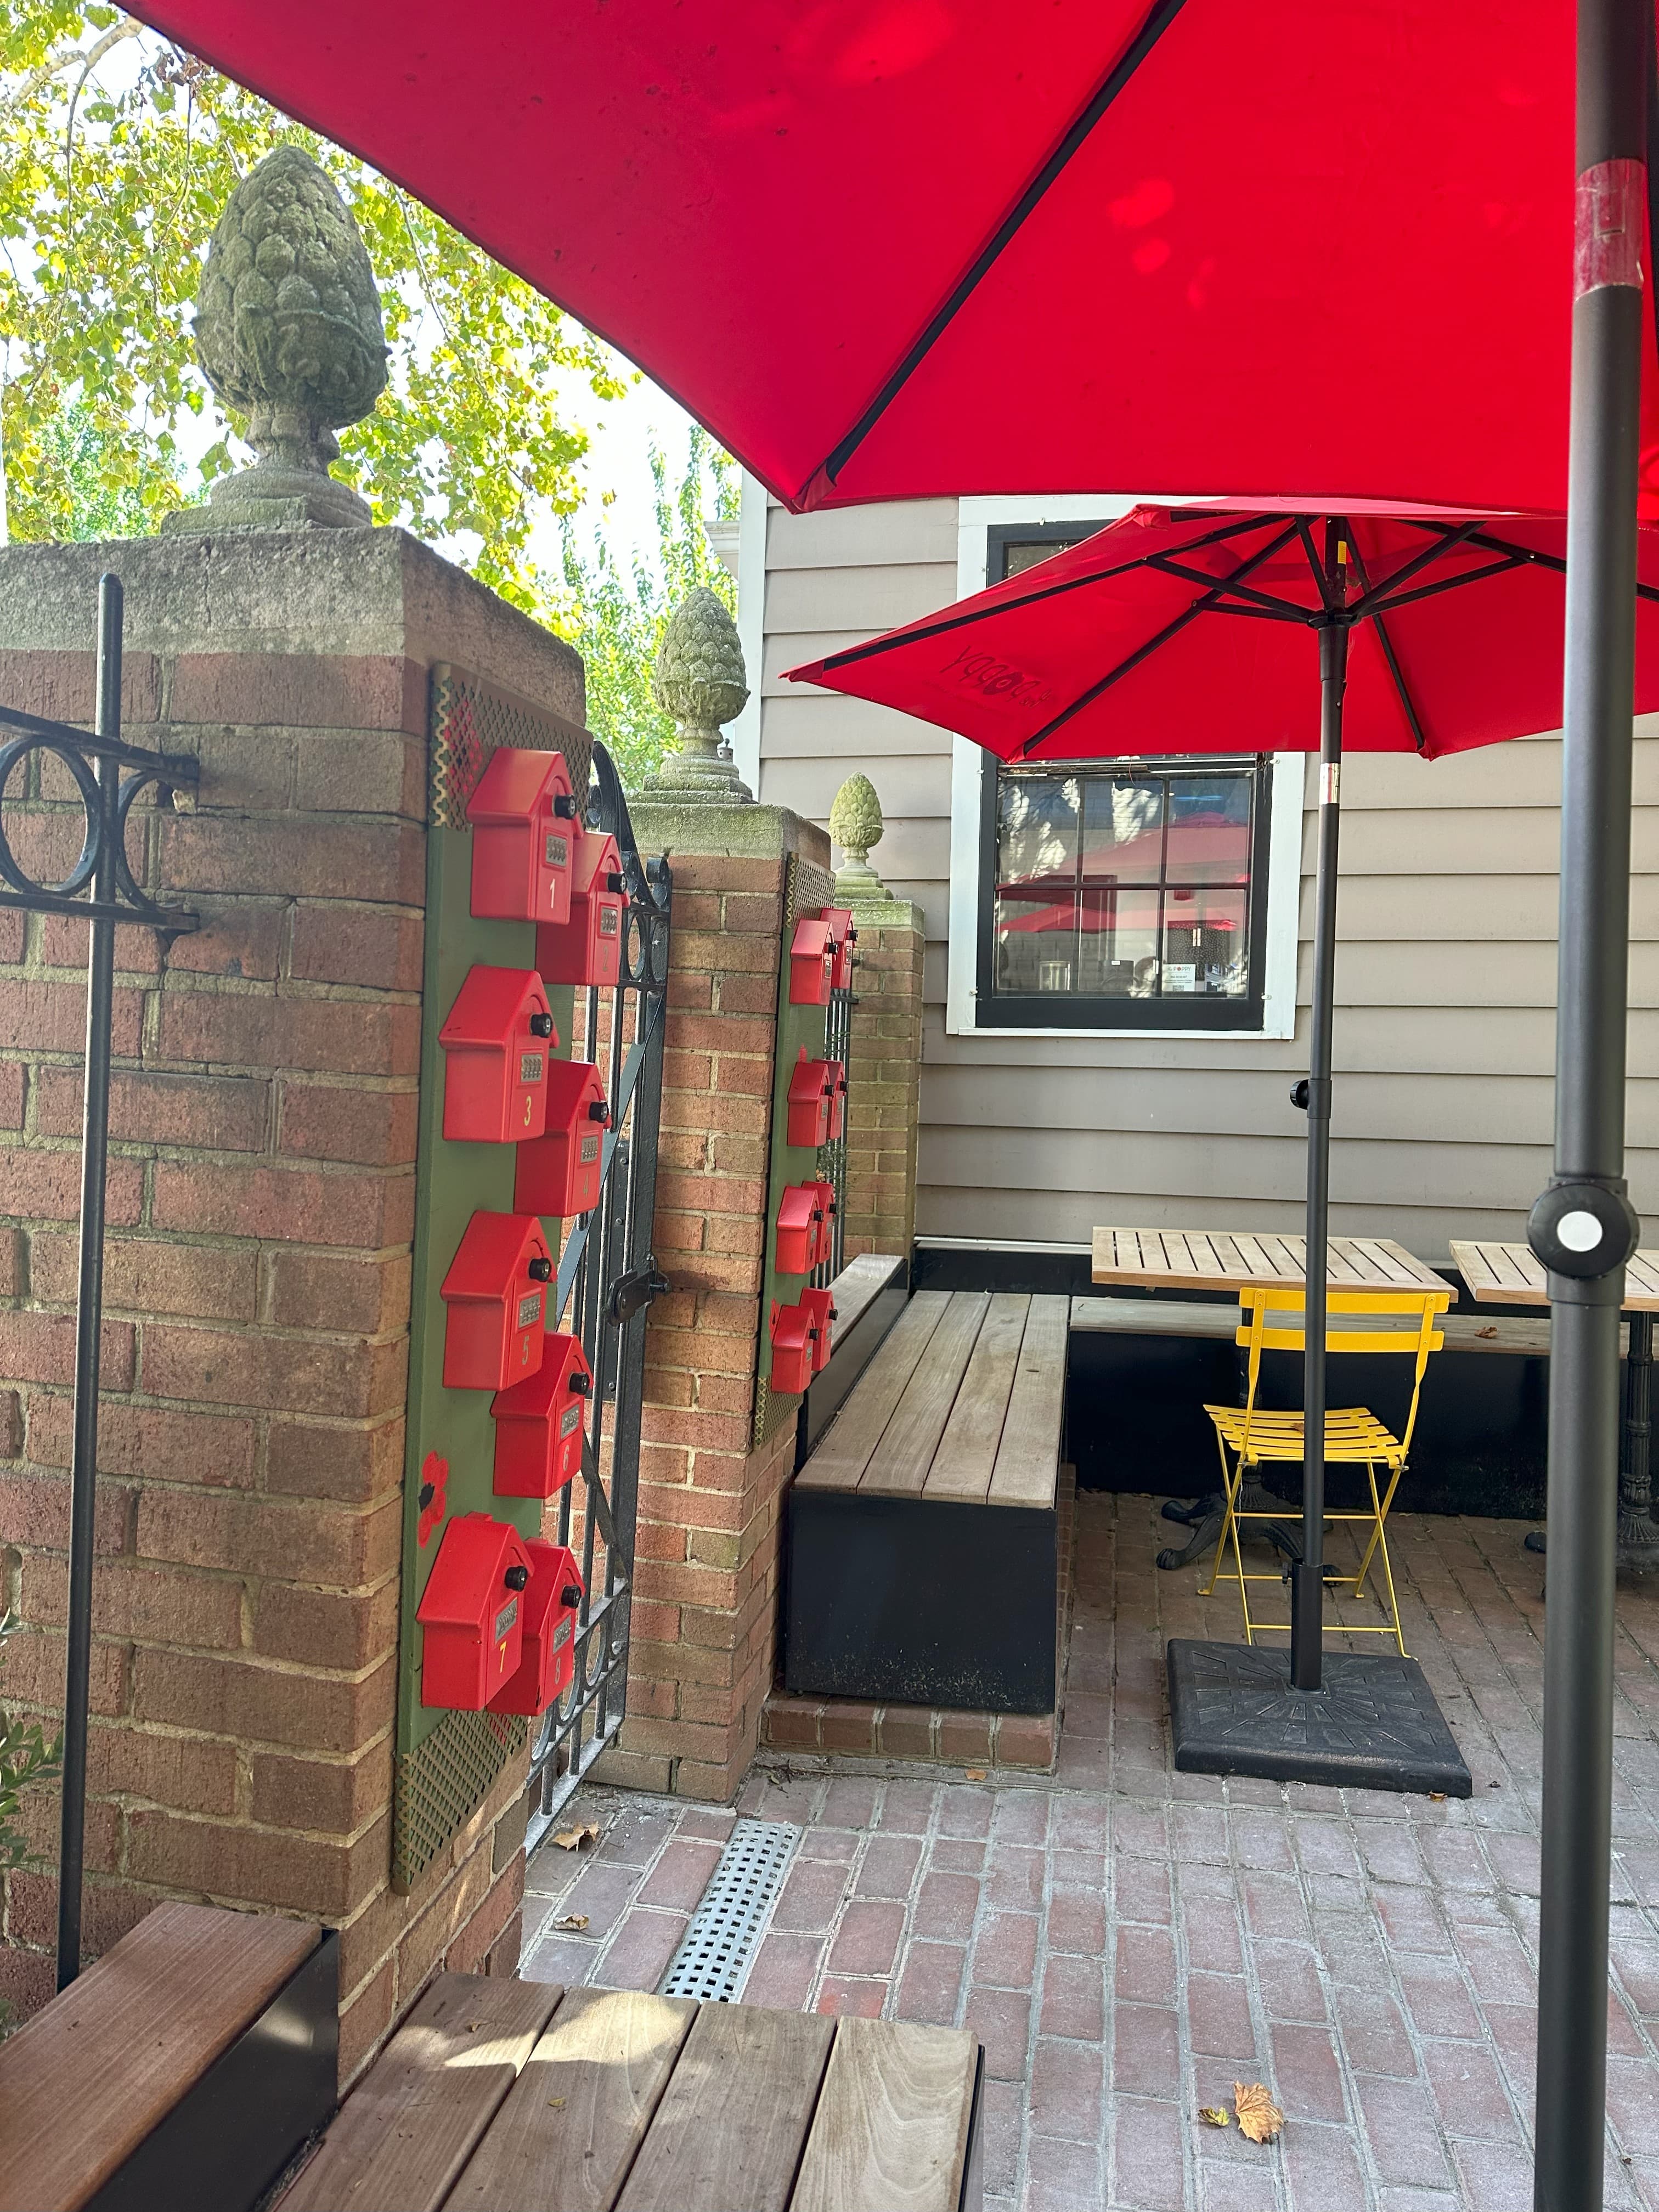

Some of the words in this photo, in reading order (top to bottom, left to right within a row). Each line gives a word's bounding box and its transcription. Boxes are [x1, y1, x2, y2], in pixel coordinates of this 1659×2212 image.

[550, 878, 555, 909] 1
[602, 945, 608, 972] 2
[524, 1096, 532, 1126] 3
[583, 1171, 589, 1199] 4
[522, 1335, 529, 1365] 5
[563, 1444, 569, 1471] 6
[500, 1641, 506, 1673] 7
[555, 1657, 561, 1685] 8
